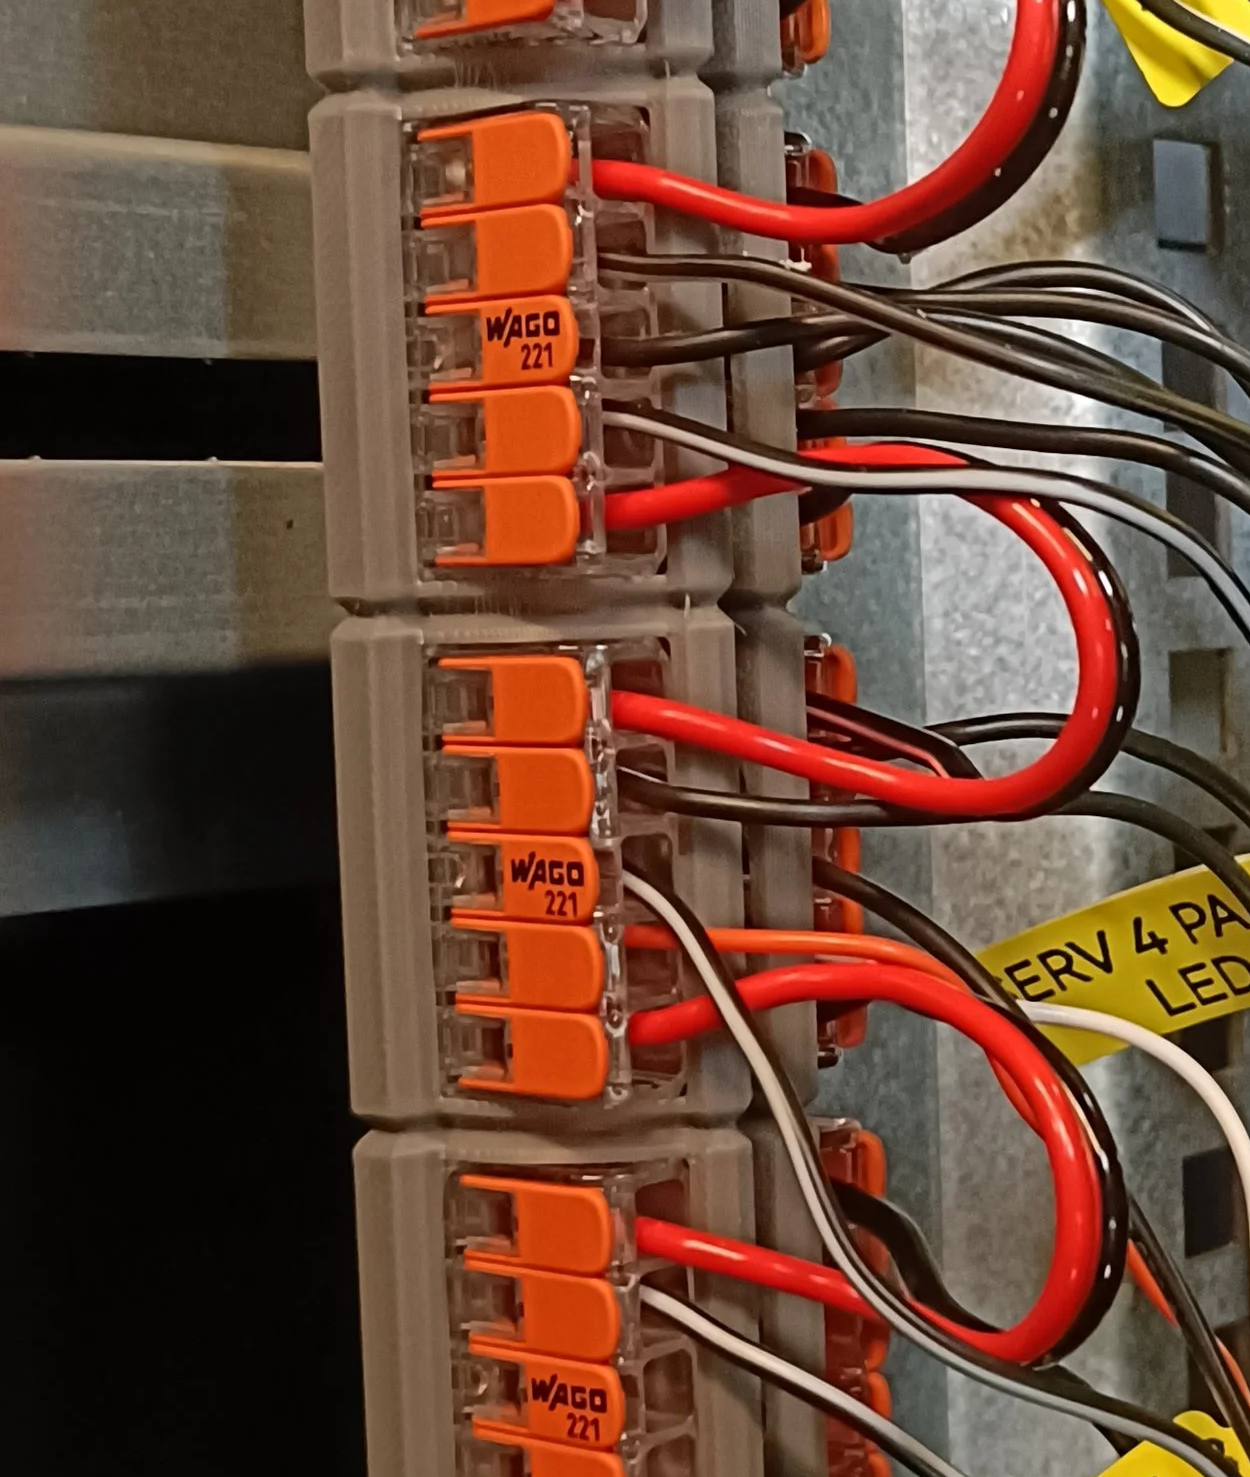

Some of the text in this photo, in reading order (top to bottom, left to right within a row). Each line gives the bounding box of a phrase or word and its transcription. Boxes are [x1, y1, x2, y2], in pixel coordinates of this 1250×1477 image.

[486, 306, 560, 348] WAGO
[521, 342, 553, 370] 221
[511, 851, 584, 890] WAGO
[545, 889, 577, 918] 221
[995, 930, 1114, 1002] ERV
[1133, 916, 1168, 955] 4
[531, 1373, 607, 1414] WAGO
[567, 1412, 600, 1442] 221
